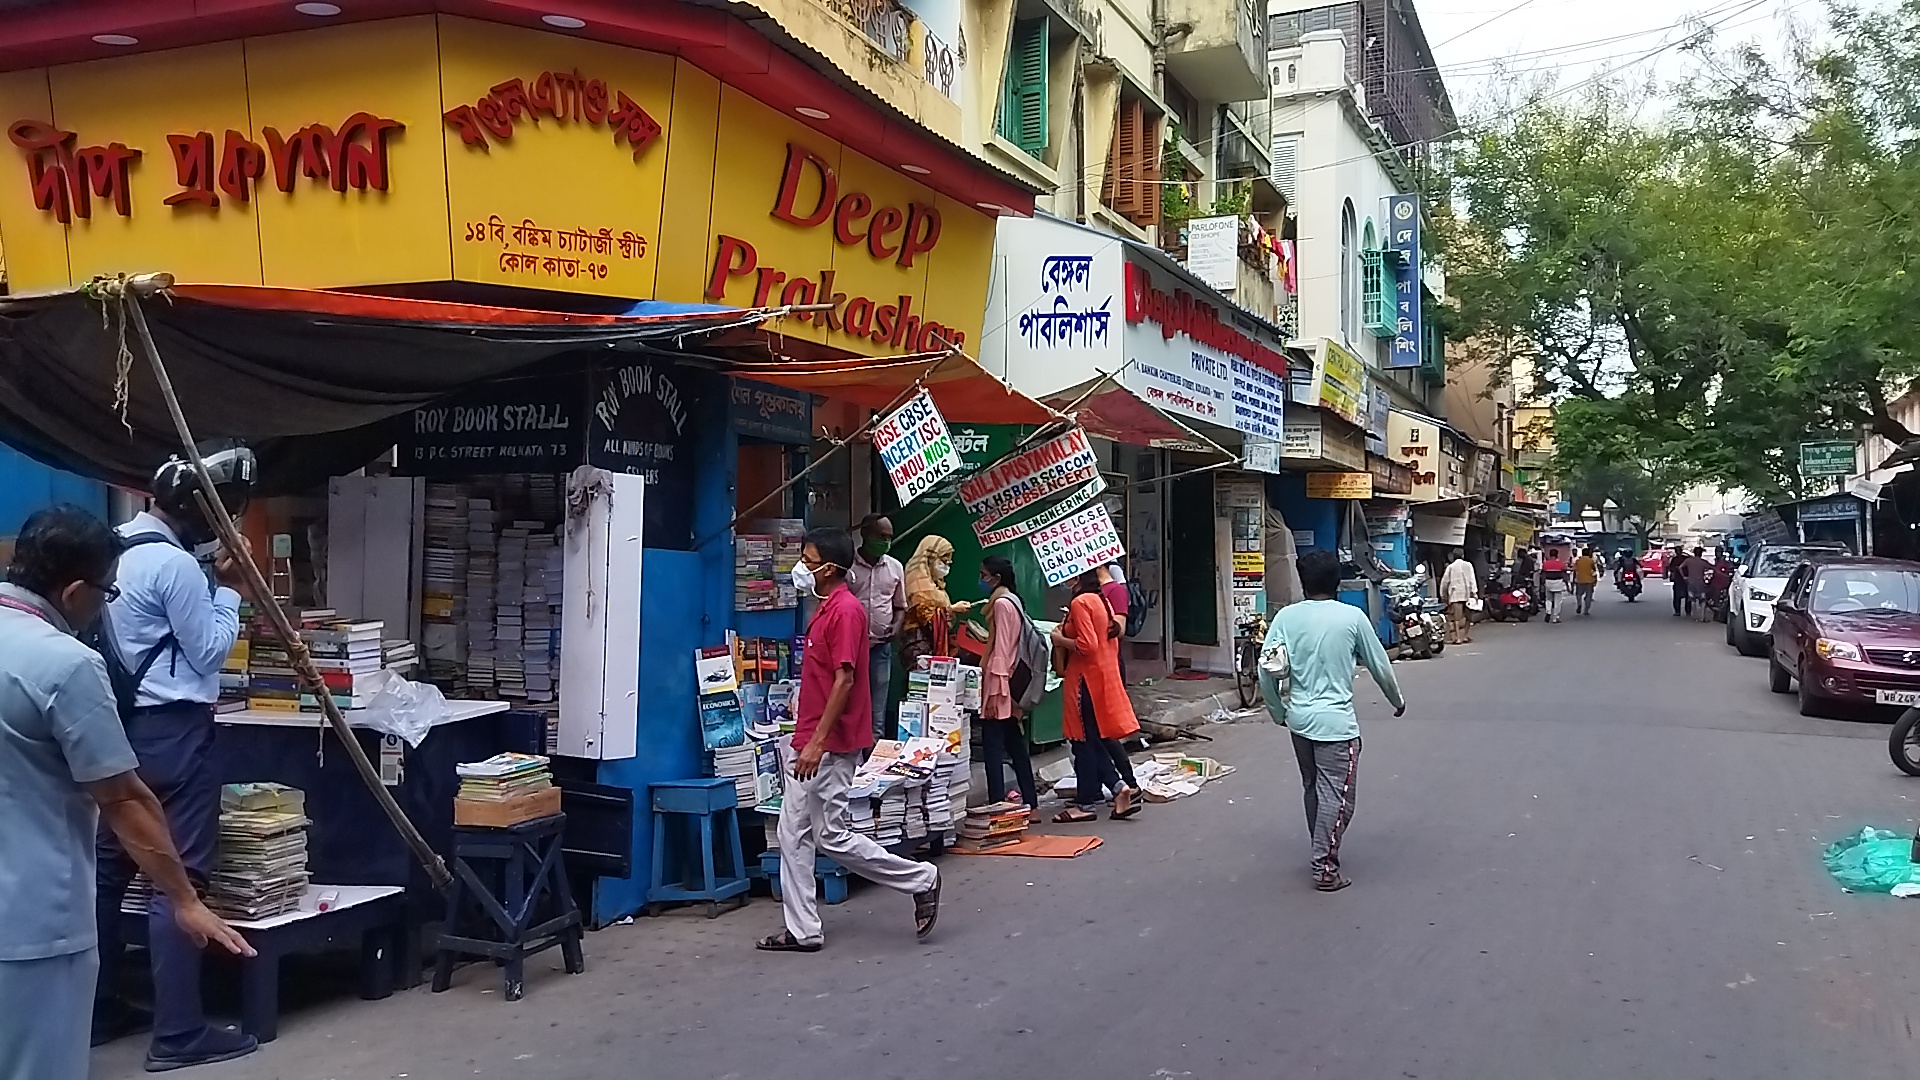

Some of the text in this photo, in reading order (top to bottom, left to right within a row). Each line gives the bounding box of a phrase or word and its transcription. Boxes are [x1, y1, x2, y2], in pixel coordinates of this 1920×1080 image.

[770, 142, 942, 268] Deep
[511, 219, 552, 248] বঙ্কিম
[1041, 255, 1094, 293] বেঙ্গল
[705, 234, 966, 354] Prakashan
[1019, 295, 1113, 349] পাবলিশার্স
[618, 365, 652, 398] BOOK
[656, 374, 688, 436] STALL
[414, 403, 569, 434] ROY BOOK STALL
[918, 416, 942, 445] ISC
[450, 445, 495, 459] STREET
[550, 443, 567, 456] 73
[603, 438, 621, 453] ALL
[907, 458, 950, 497] BOOKS
[980, 489, 1090, 547] MEDICAL ENGINEERING
[1086, 544, 1120, 567] NEW
[702, 699, 736, 710] ECONOMICS
